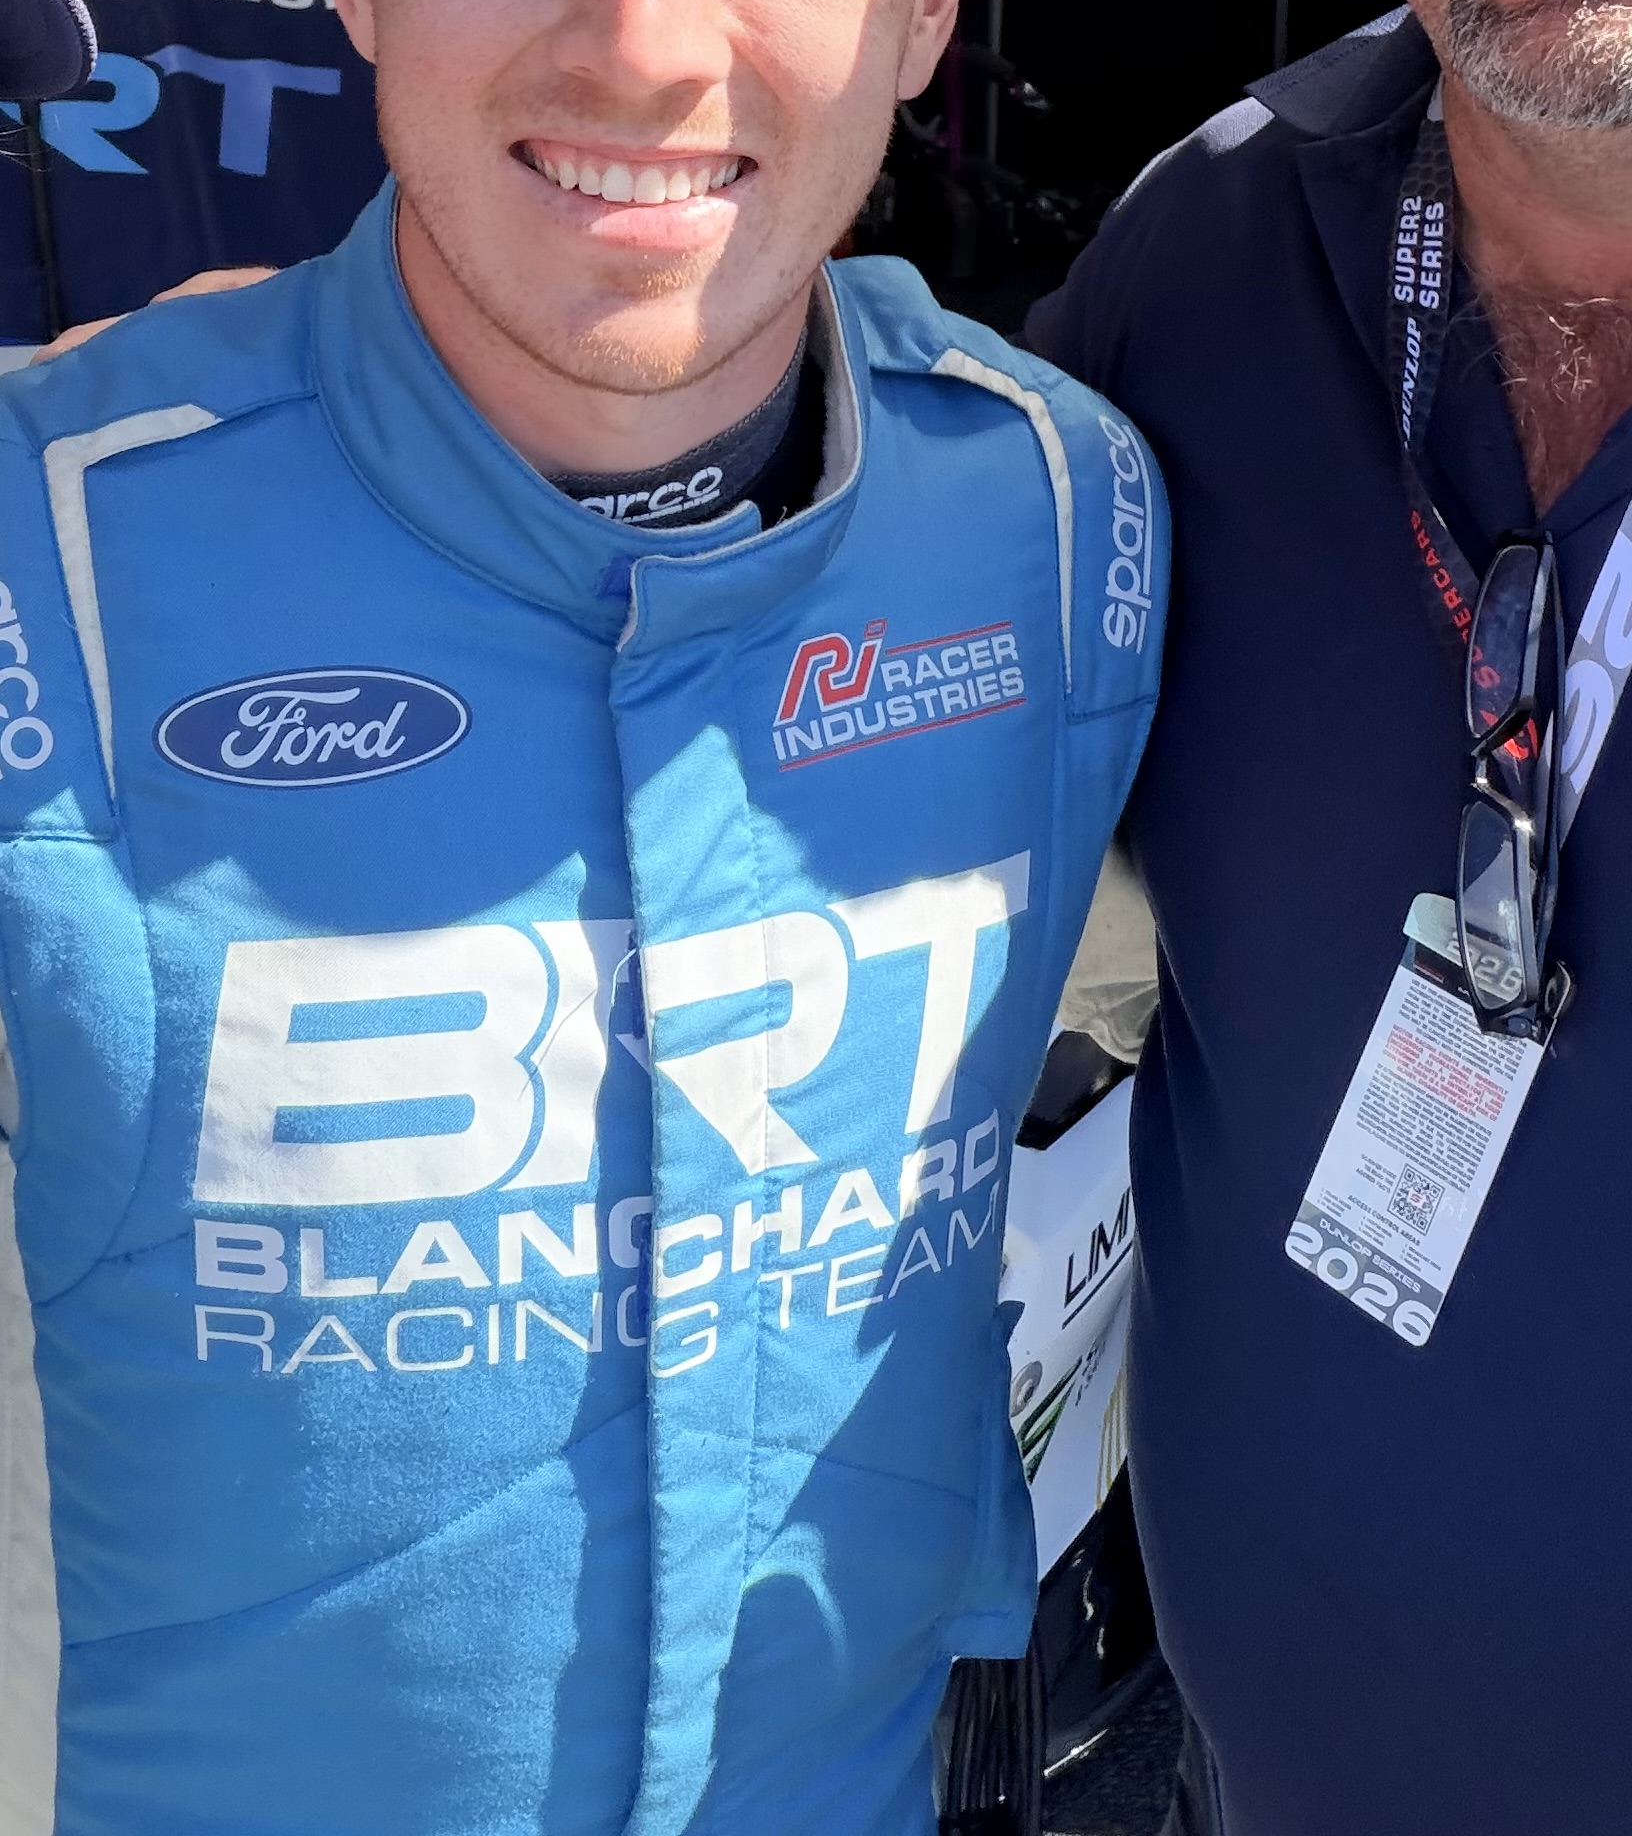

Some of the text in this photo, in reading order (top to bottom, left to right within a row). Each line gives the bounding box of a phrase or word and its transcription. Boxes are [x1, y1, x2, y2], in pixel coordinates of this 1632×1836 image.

[1393, 195, 1423, 304] SUPER2
[1419, 201, 1445, 310] SERIES
[578, 466, 724, 520] arco
[1101, 414, 1153, 651] sparco
[771, 664, 1027, 762] INDUSTRIES
[880, 632, 1019, 692] RACER
[220, 686, 409, 769] Ford
[193, 849, 1032, 1207] BRT
[193, 1108, 1004, 1298] BLANCHARD
[1318, 1218, 1373, 1260] DUNLOP
[1369, 1251, 1422, 1294] SERIES
[193, 1178, 1000, 1382] RACING TEAM
[1284, 1220, 1437, 1348] 2026
